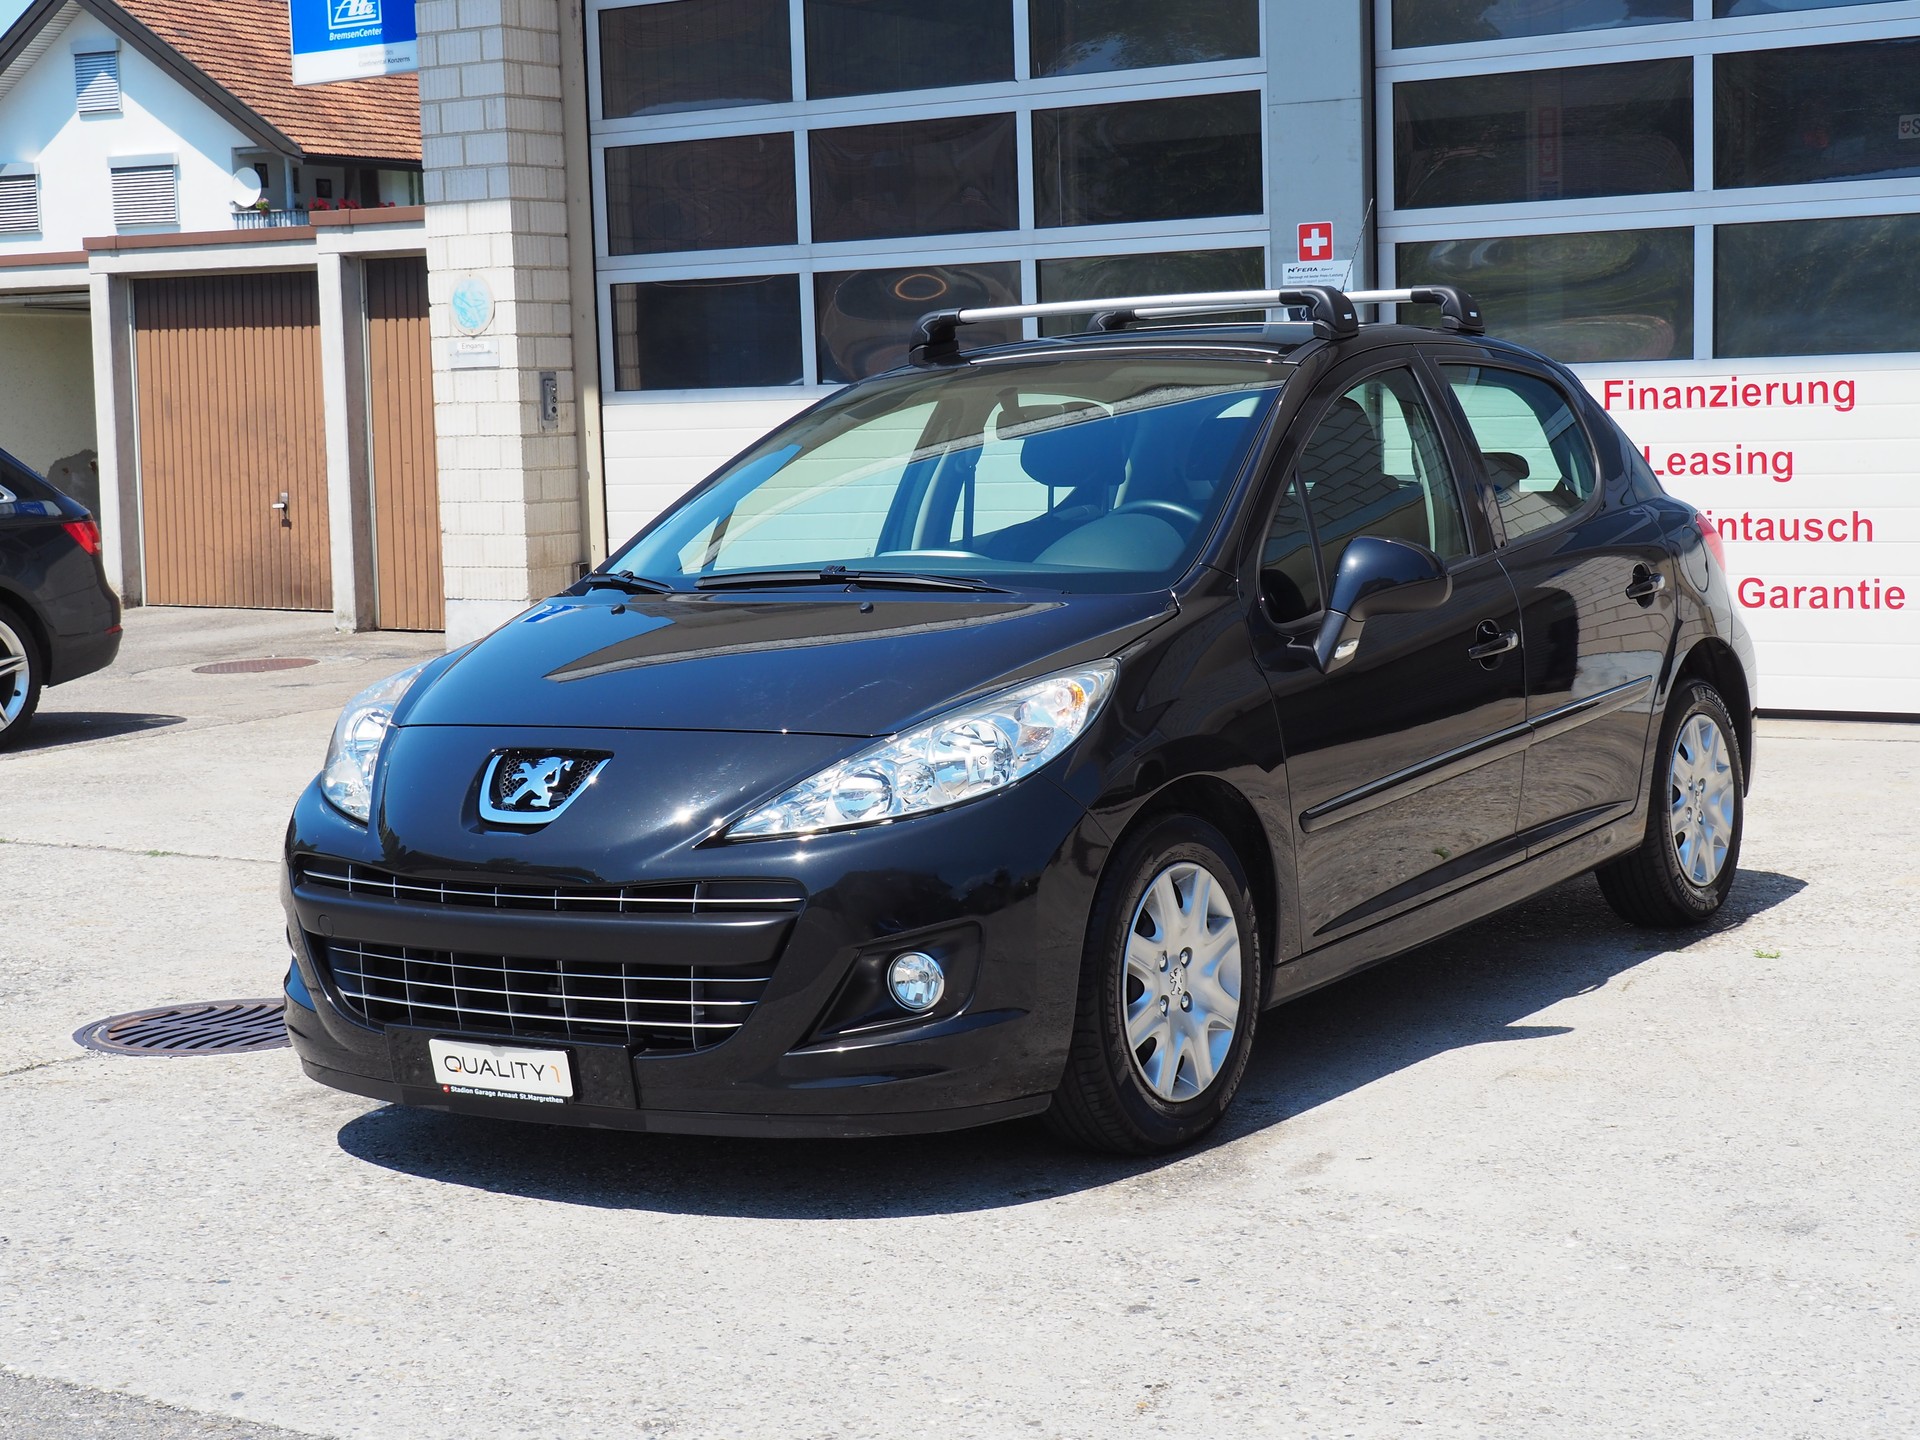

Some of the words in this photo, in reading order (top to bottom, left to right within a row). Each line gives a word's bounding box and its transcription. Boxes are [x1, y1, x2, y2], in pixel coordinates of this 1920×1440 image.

[329, 28, 382, 41] BremsenCenter
[1604, 376, 1856, 412] Finanzierung
[1706, 510, 1873, 542] ntausch
[1738, 577, 1906, 610] Garantie
[444, 1055, 545, 1081] QUALITY
[451, 1085, 474, 1094] Stadion
[474, 1088, 496, 1098] Garage
[497, 1091, 519, 1099] Arnaut
[519, 1094, 564, 1104] St.Margrethen
